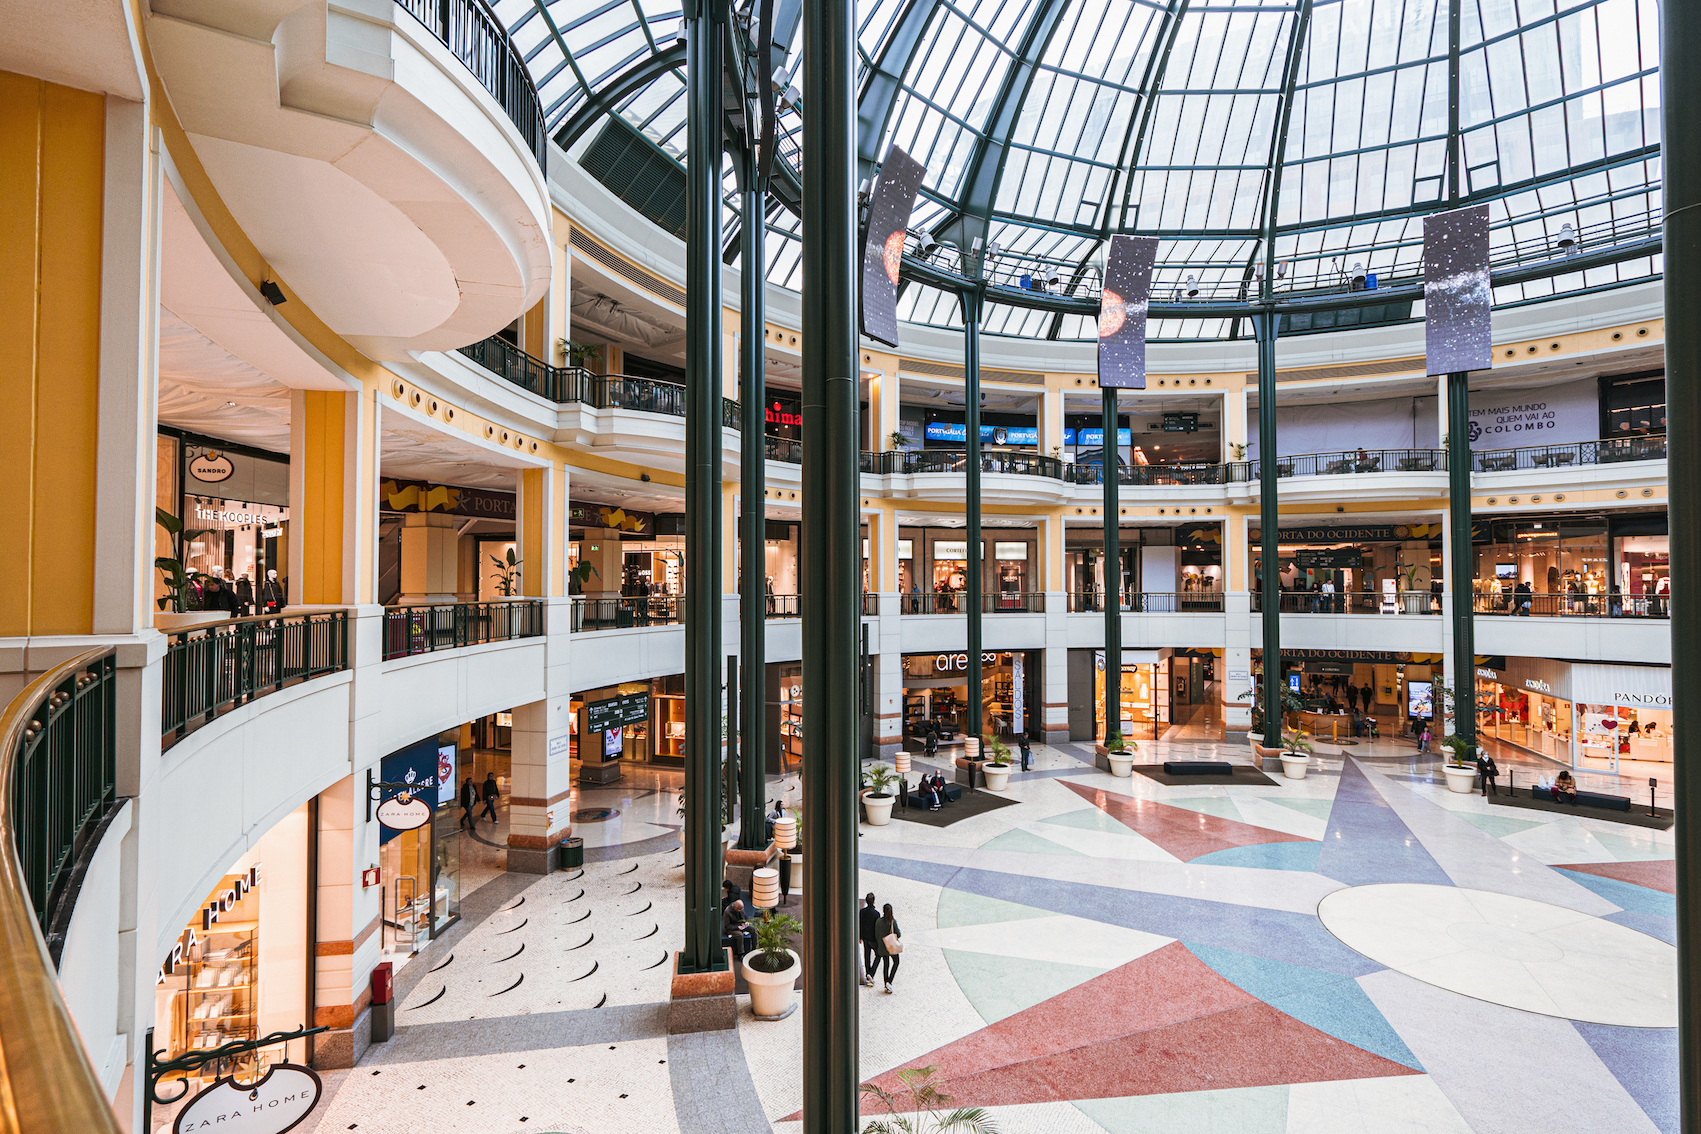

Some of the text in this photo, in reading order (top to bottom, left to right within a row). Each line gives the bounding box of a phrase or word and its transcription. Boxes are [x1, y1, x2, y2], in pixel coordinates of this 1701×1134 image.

[1487, 406, 1510, 415] MAIS
[1512, 402, 1547, 414] MUNDO
[1496, 410, 1556, 425] QUEM VAI AO
[1484, 420, 1556, 434] COLOMBO
[474, 497, 517, 514] PORTA
[197, 507, 268, 526] THE KOOPLES
[1307, 530, 1325, 540] DO
[1327, 528, 1391, 540] OCIDENTE
[936, 653, 968, 671] are
[1308, 650, 1326, 659] DO
[1328, 650, 1392, 660] OCIDENTE
[1014, 659, 1023, 720] SALDOS
[155, 862, 263, 987] ARA HOME
[184, 1089, 310, 1133] ZARA HOME
